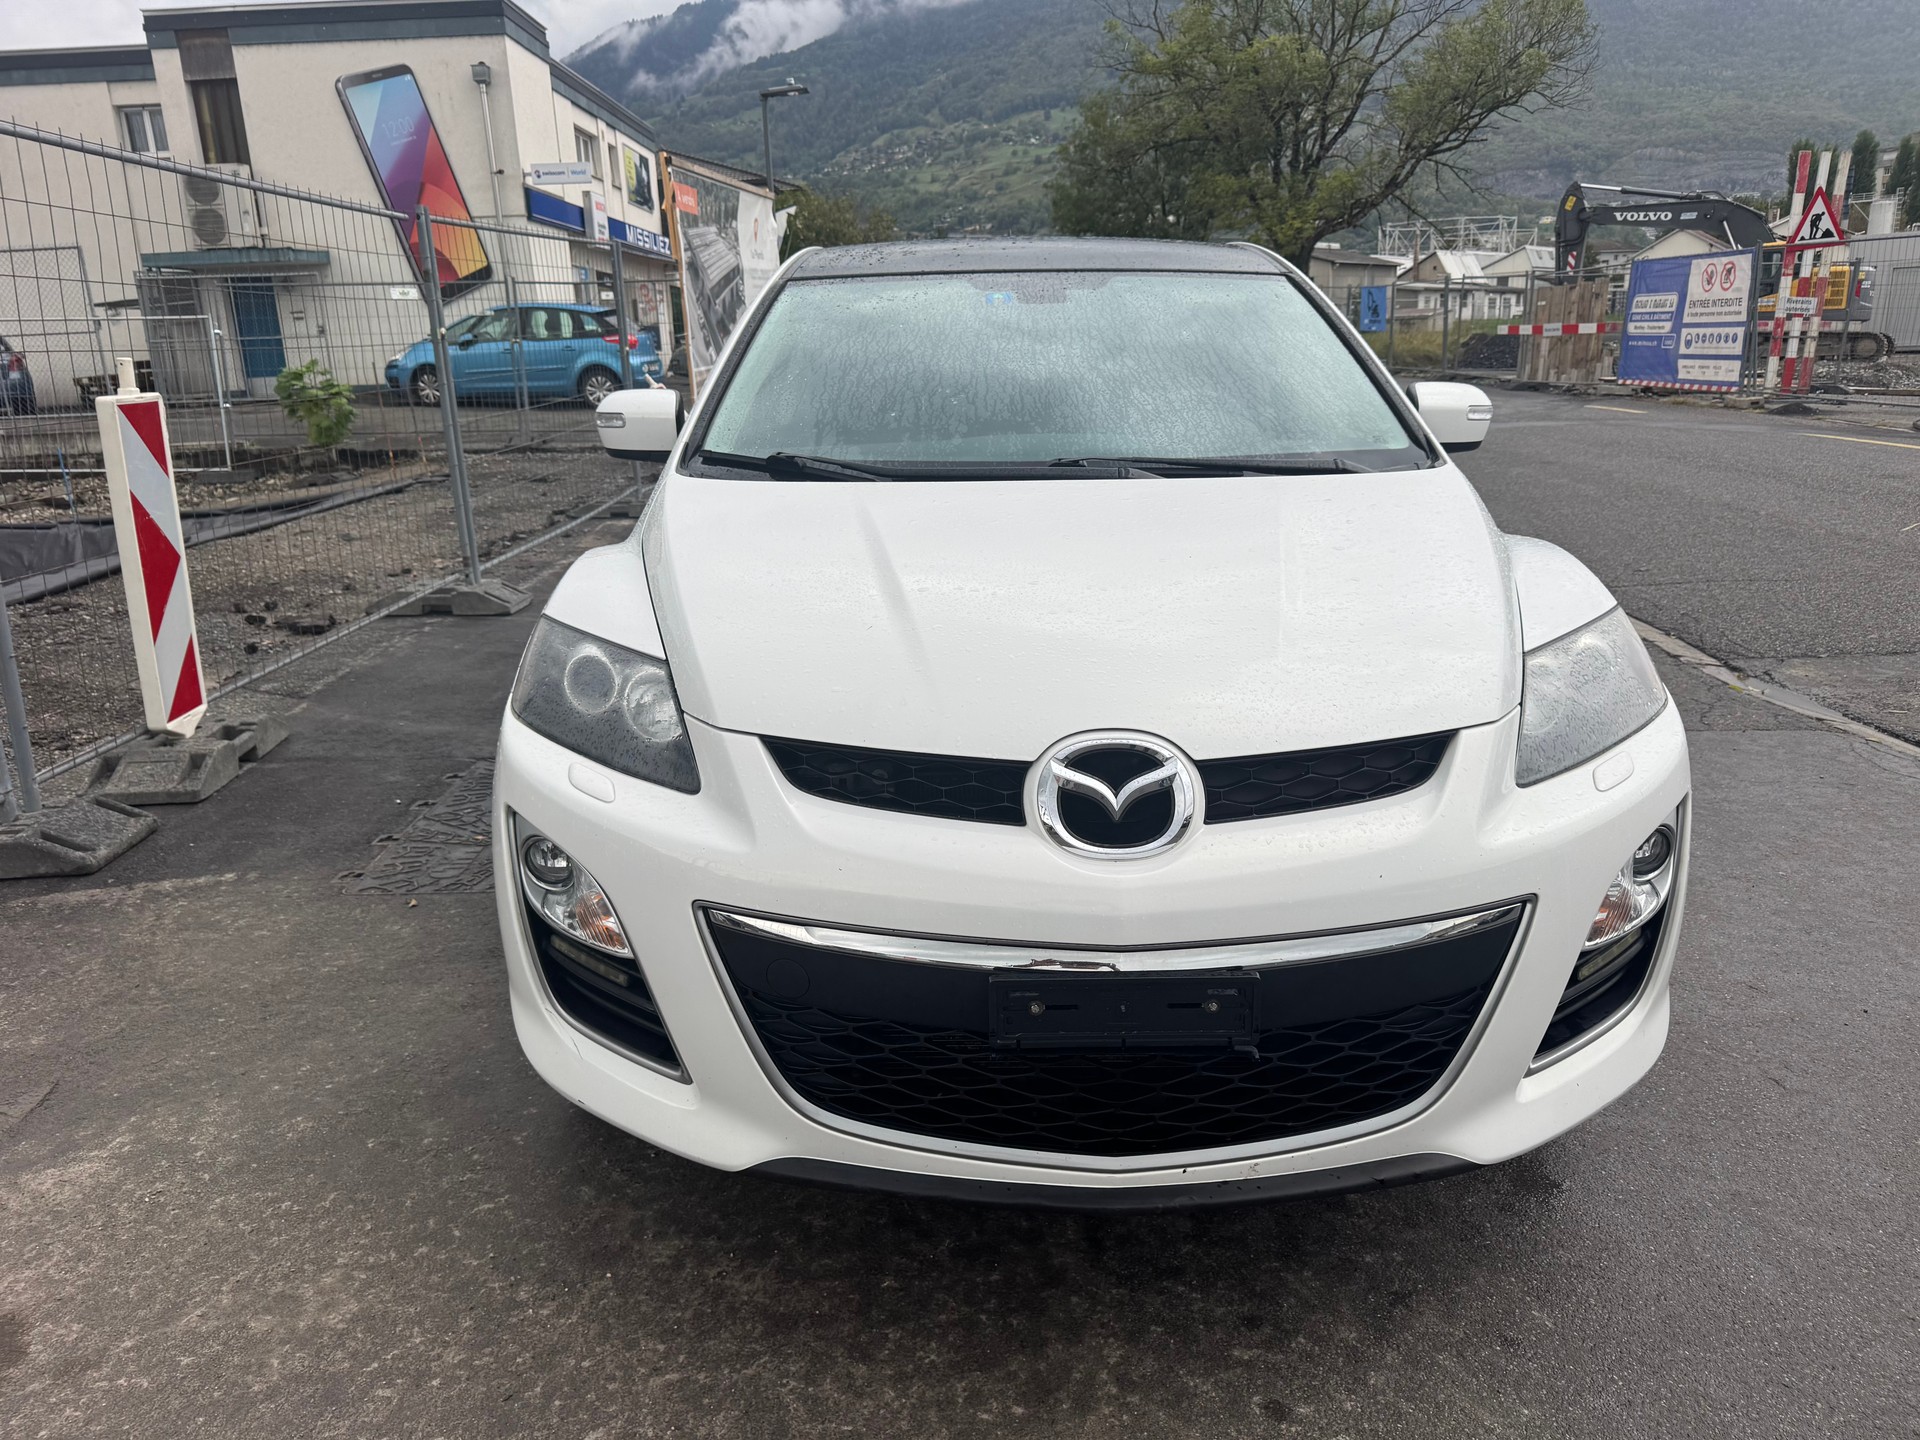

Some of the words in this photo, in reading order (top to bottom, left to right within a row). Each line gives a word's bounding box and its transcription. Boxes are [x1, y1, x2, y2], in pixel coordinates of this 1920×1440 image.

[1613, 211, 1673, 222] VOLVO
[625, 224, 671, 255] MISSILIEZ
[1688, 297, 1711, 309] ENTRÉE
[1711, 297, 1743, 308] INTERDITE
[1786, 297, 1812, 305] Riverains
